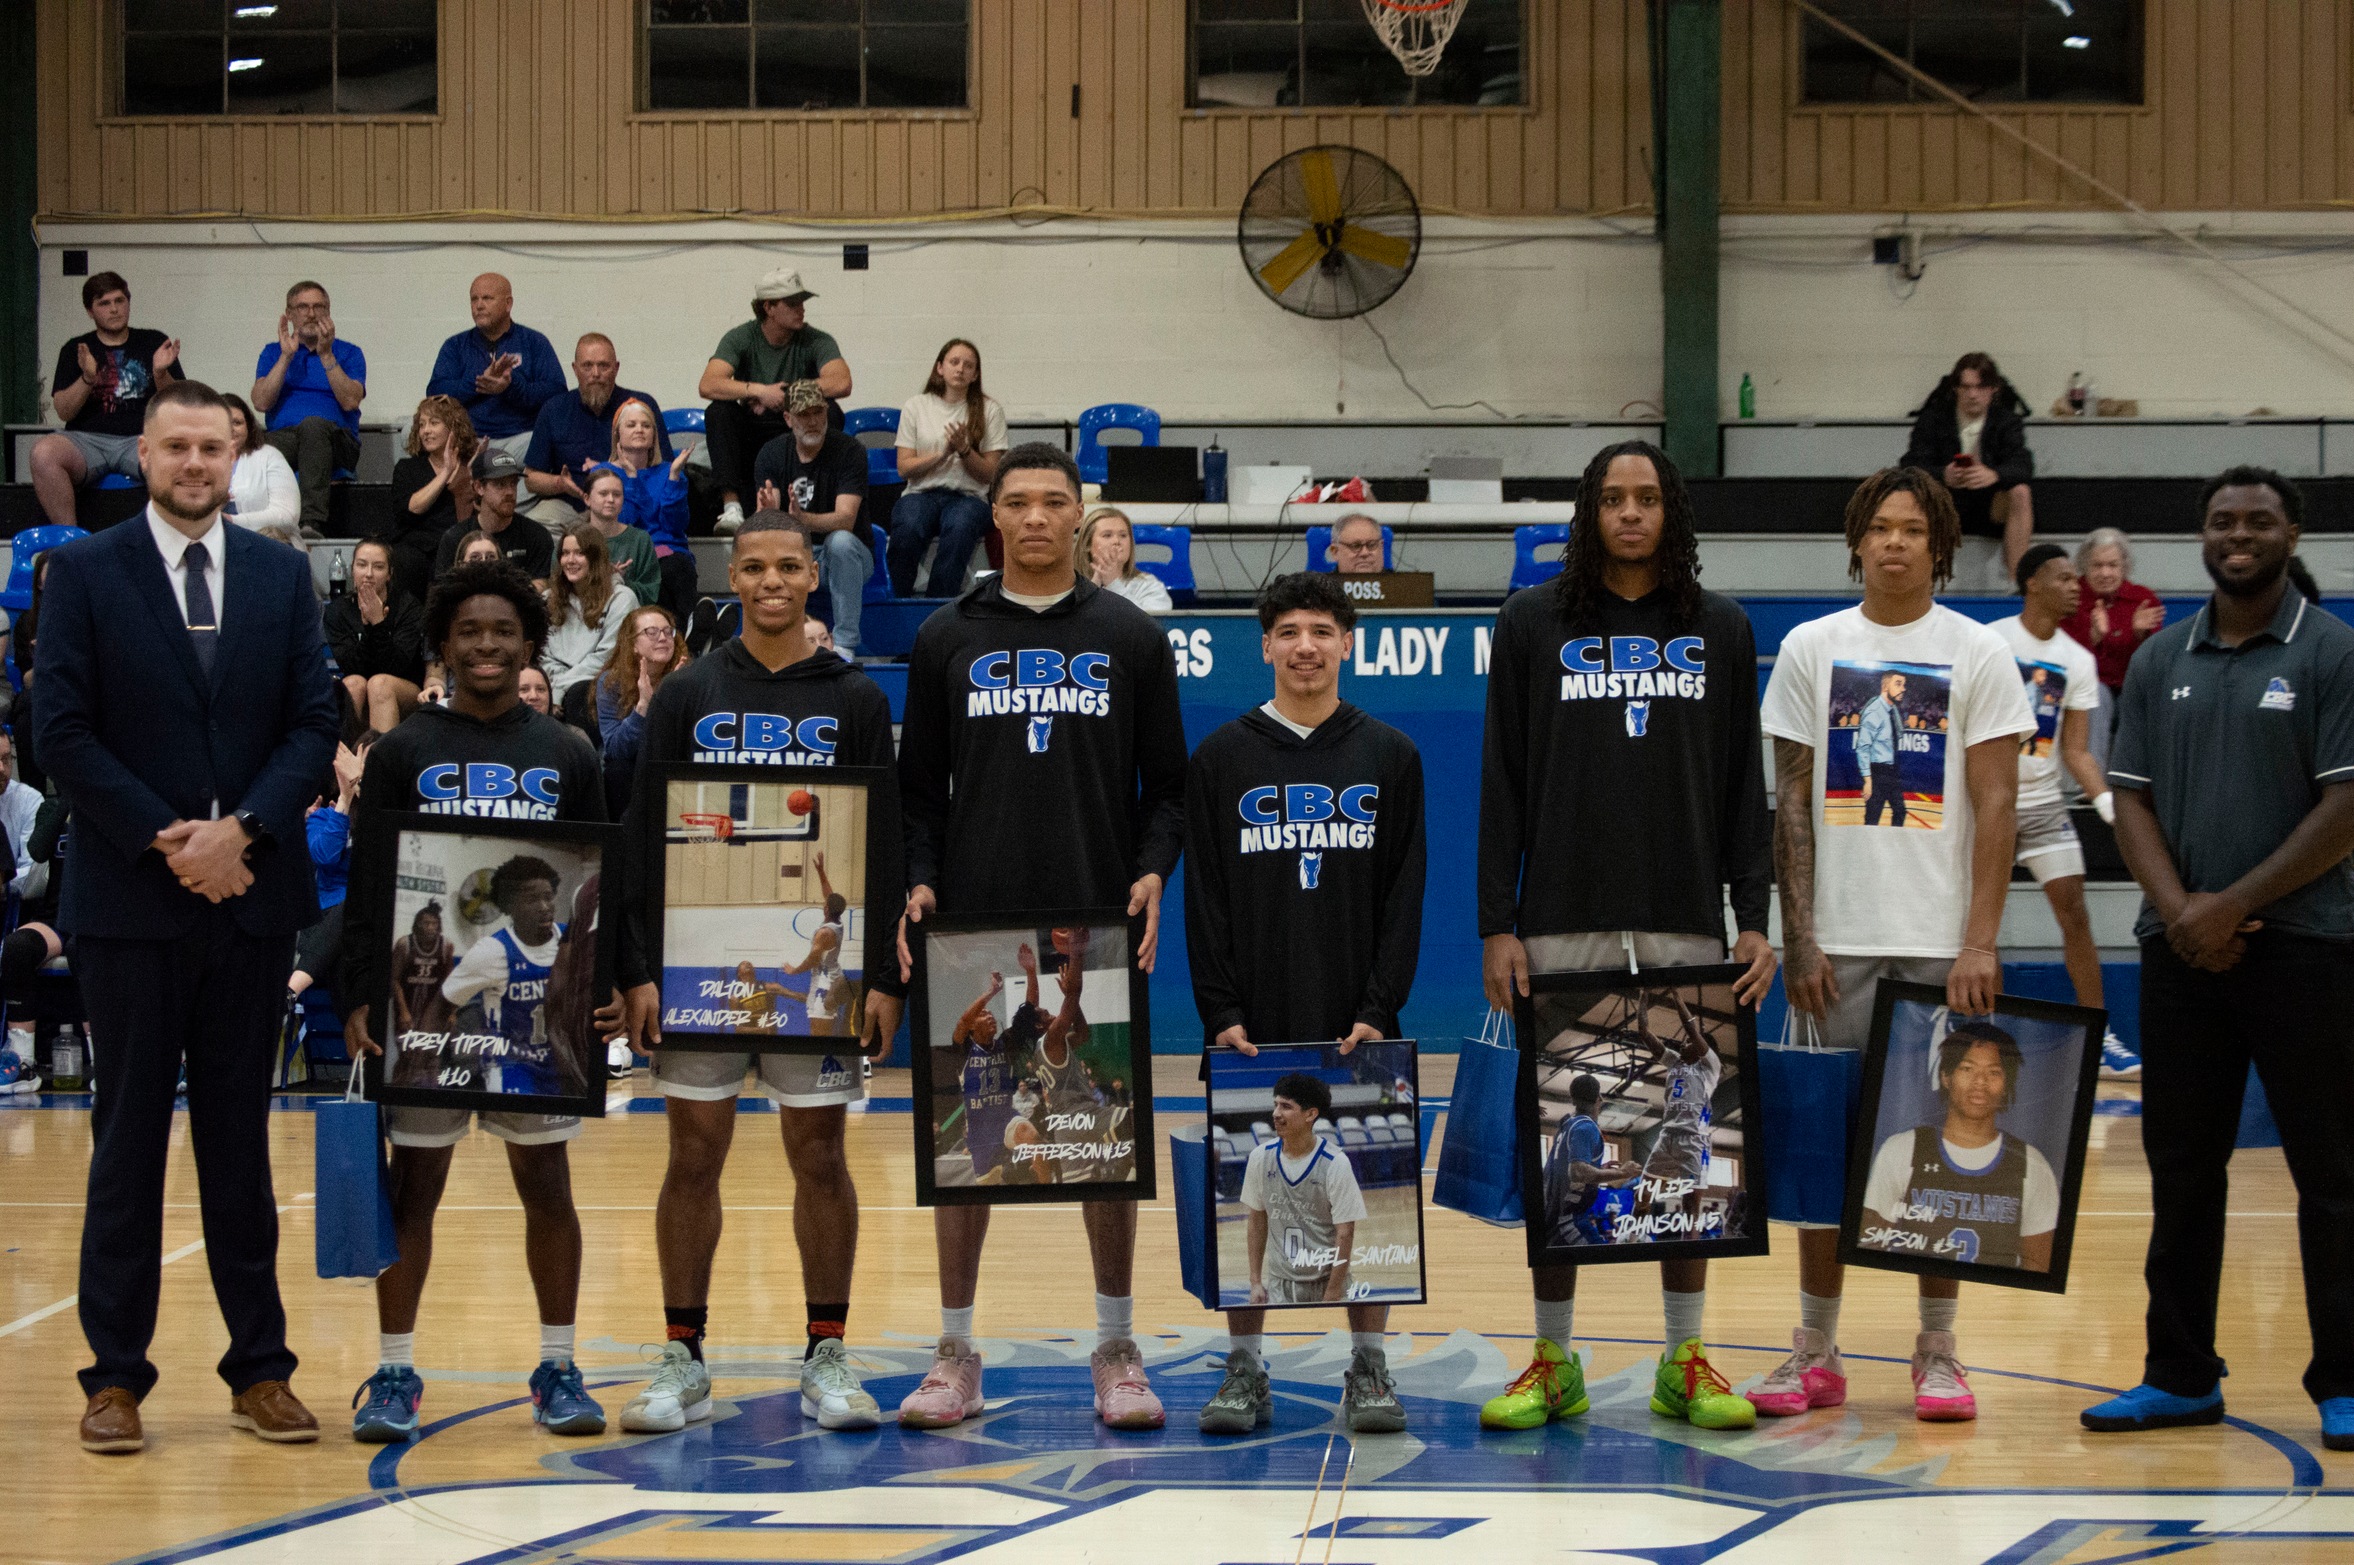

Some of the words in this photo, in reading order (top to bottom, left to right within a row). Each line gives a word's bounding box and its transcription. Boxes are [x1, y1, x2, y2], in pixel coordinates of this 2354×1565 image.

[1344, 581, 1385, 600] POSS.
[1354, 627, 1450, 676] LADY
[1559, 635, 1706, 674] CBC
[969, 648, 1110, 690] CBC
[1560, 672, 1706, 701] MUSTANGS
[967, 687, 1110, 717] MUSTANGS
[693, 712, 838, 753] CBC
[417, 762, 560, 806] CBC
[1238, 783, 1379, 825] CBC
[1240, 822, 1377, 854] MUSTANGS
[698, 980, 755, 999] DALTON
[662, 1008, 752, 1027] ALEXANDER
[757, 1010, 788, 1029] #30
[399, 1029, 451, 1056] TREY
[451, 1032, 511, 1057] TIPPIN
[437, 1066, 472, 1087] #10
[815, 1070, 853, 1089] CBC
[1672, 1078, 1685, 1099] 5
[1045, 1112, 1096, 1132] DEVON
[1633, 1177, 1695, 1204] TYLER
[1291, 1245, 1348, 1271] ANGEL
[1346, 1281, 1371, 1300] #0
